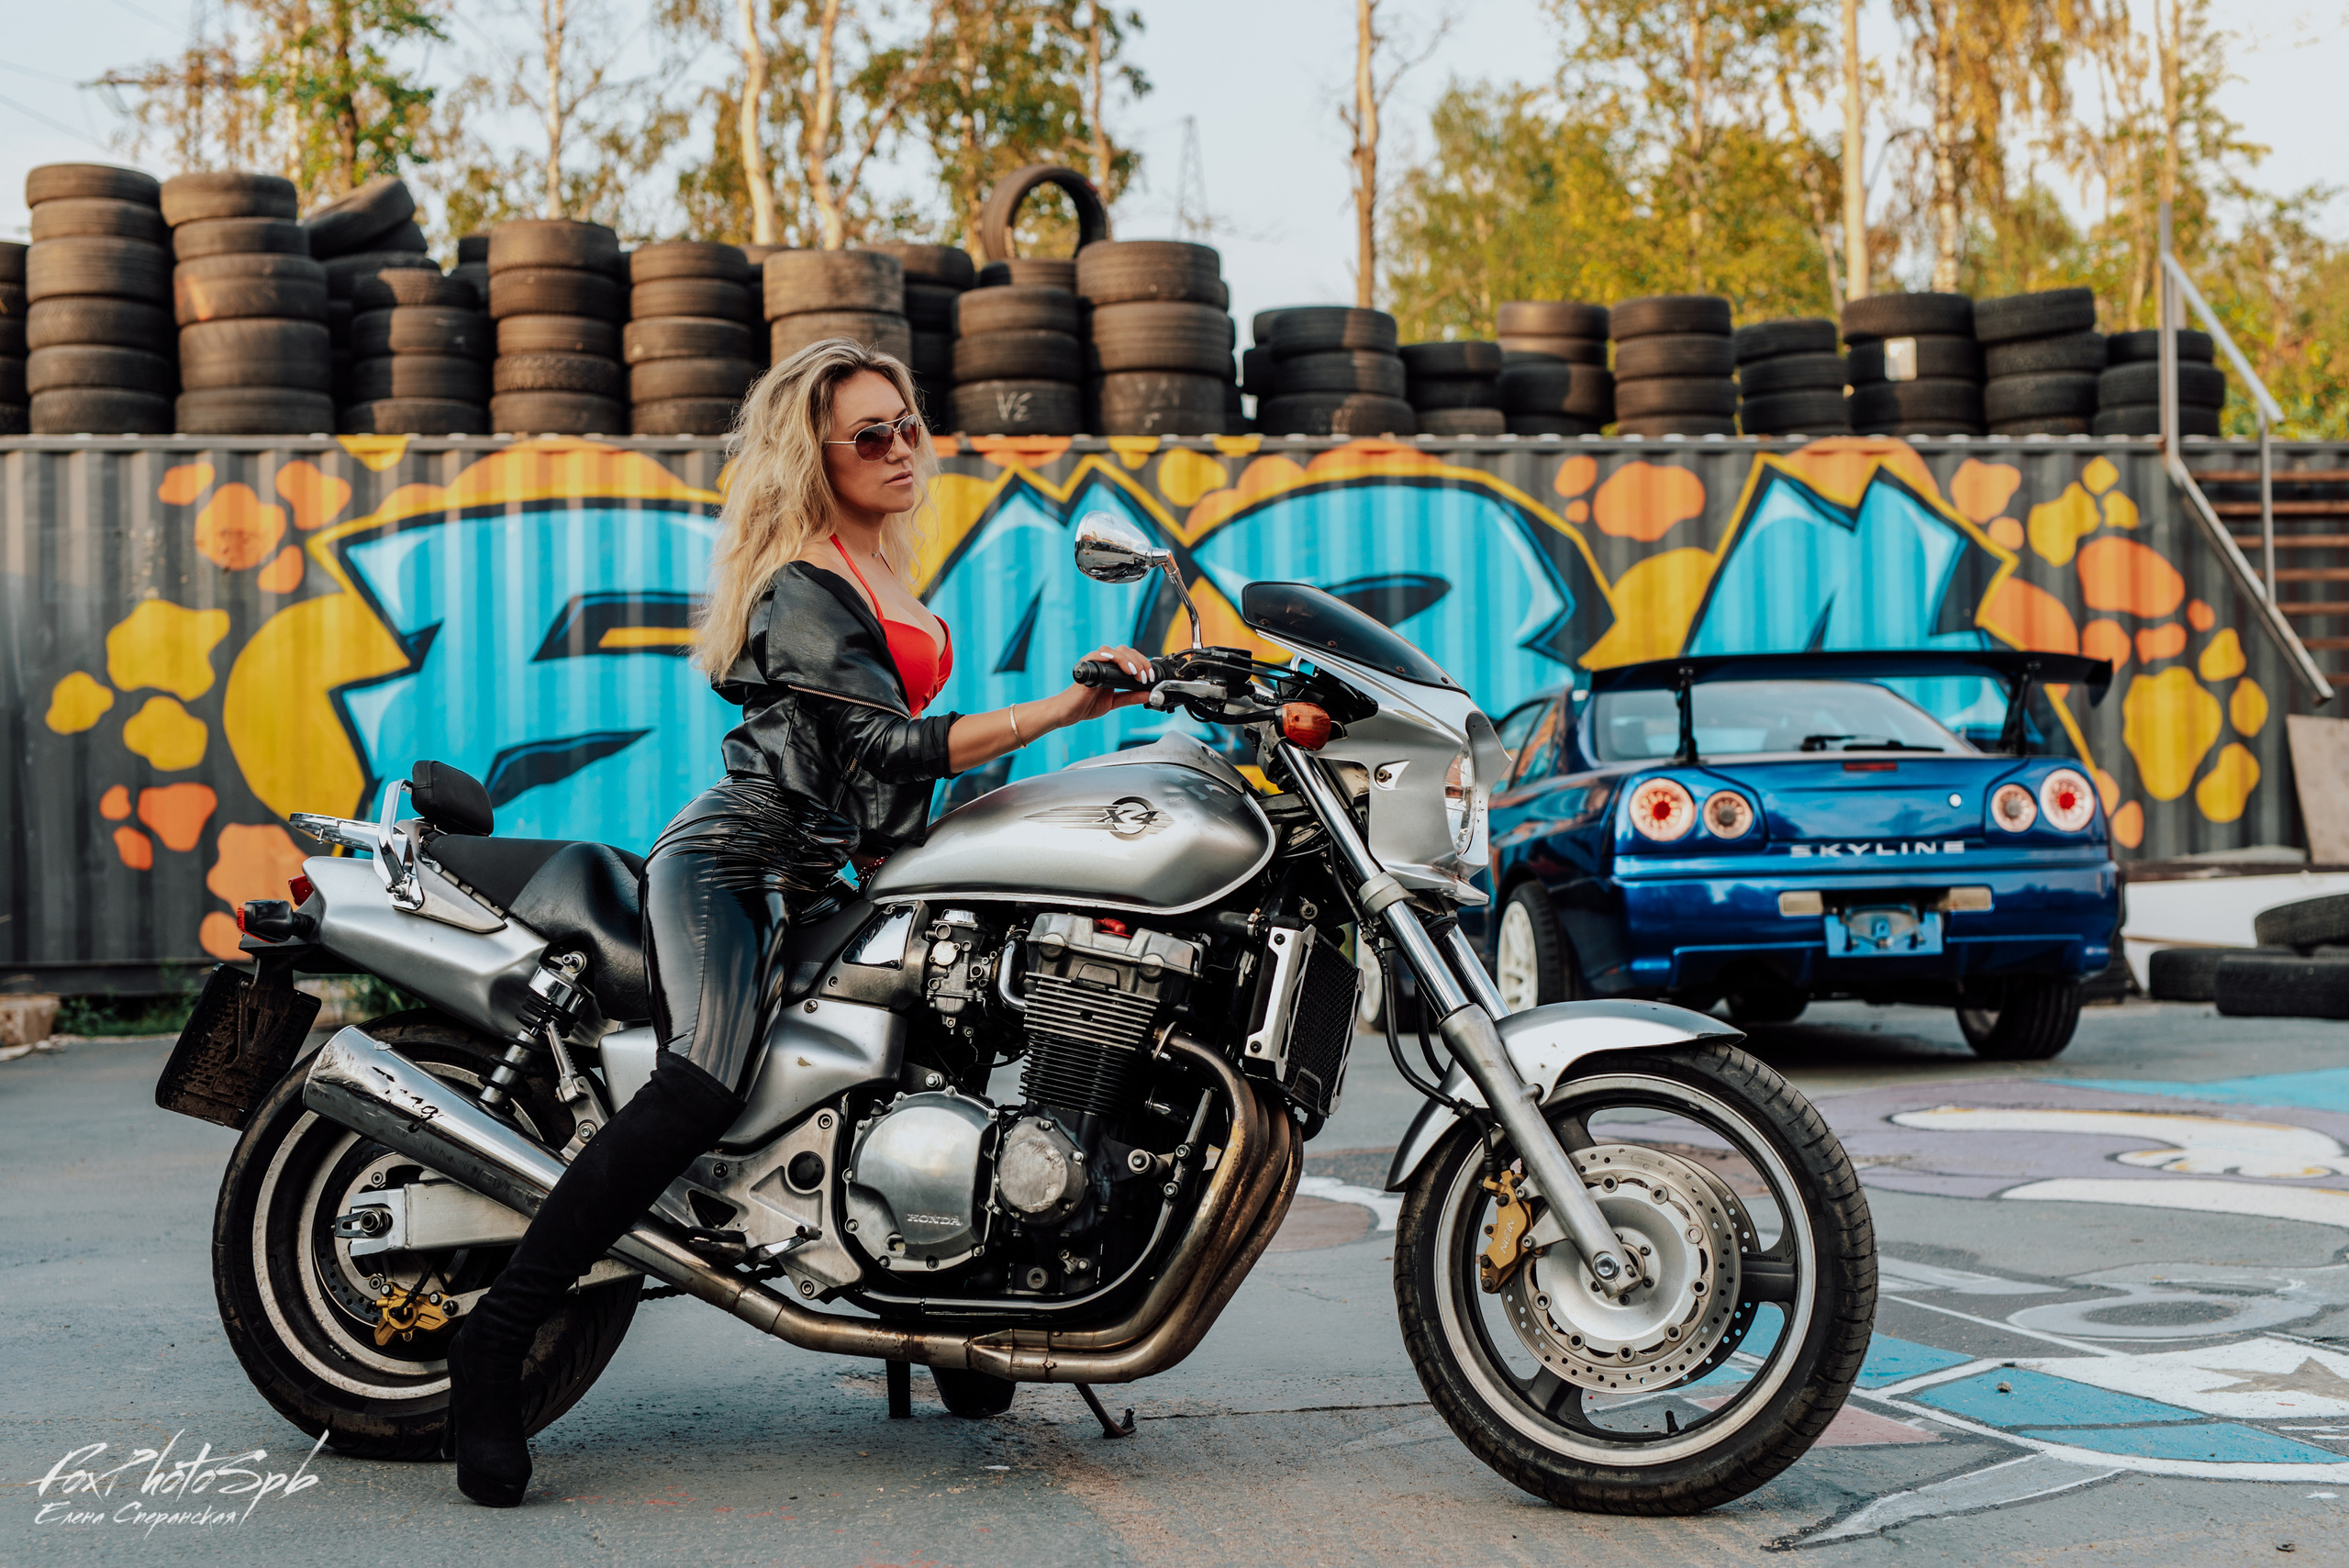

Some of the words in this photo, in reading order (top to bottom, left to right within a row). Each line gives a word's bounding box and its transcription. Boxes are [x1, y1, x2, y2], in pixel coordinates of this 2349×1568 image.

[1096, 809, 1159, 825] X4
[1790, 840, 1965, 858] SKYLINE
[907, 1213, 962, 1227] HONDA
